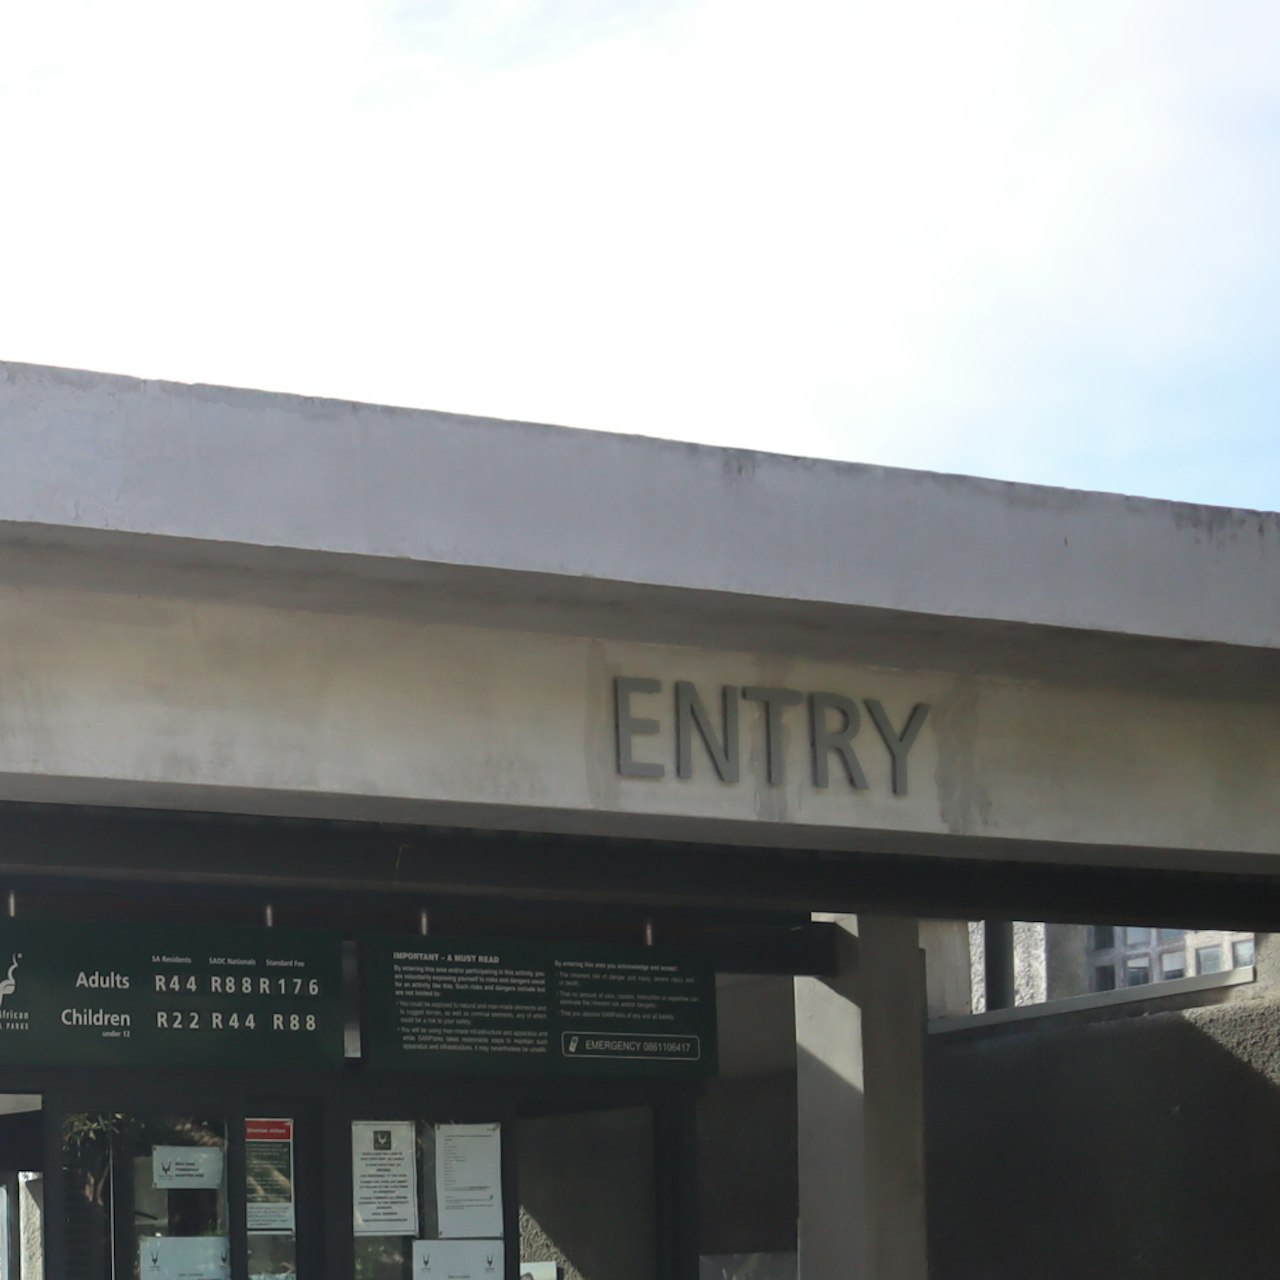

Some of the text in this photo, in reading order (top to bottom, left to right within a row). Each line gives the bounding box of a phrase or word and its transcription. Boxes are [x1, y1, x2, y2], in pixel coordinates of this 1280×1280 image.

[613, 676, 931, 797] ENTRY
[393, 952, 439, 961] IMPORTANT
[76, 971, 130, 988] Adults
[61, 1008, 130, 1026] Children
[585, 1040, 641, 1051] EMERGENCY
